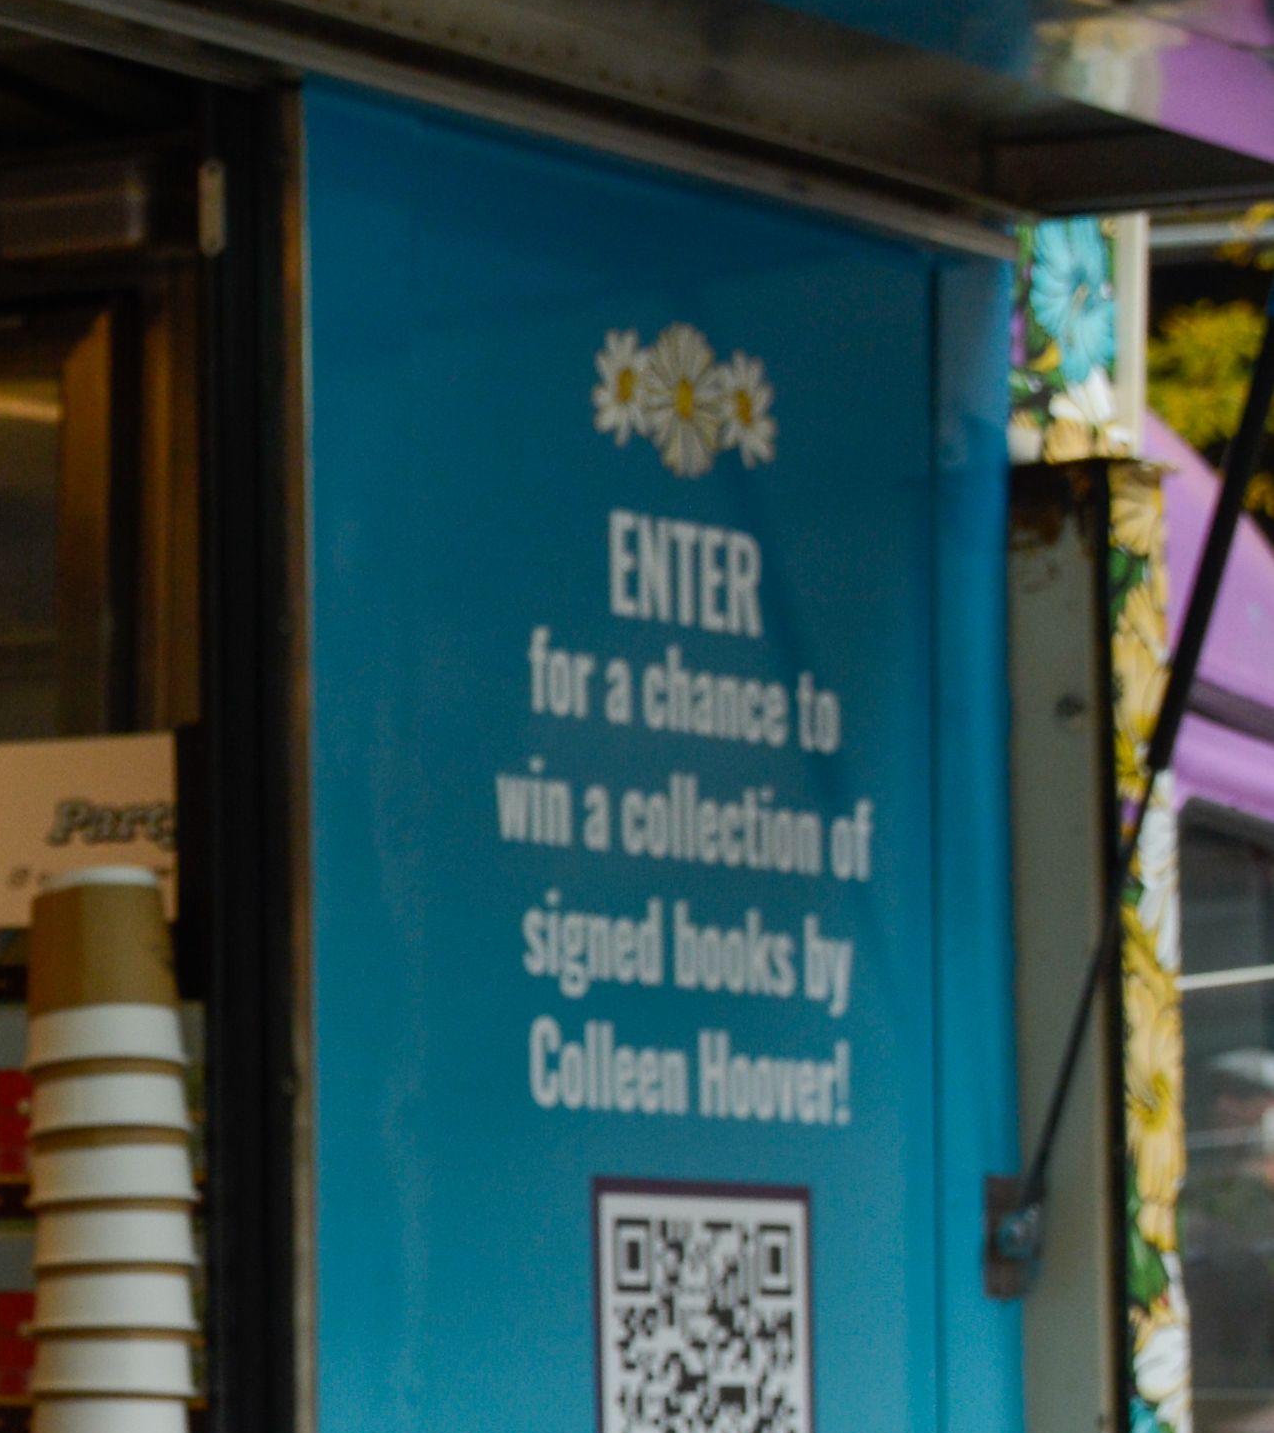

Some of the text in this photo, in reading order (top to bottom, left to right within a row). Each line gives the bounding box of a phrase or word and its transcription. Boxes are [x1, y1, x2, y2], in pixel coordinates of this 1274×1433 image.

[609, 509, 762, 638] ENTER
[528, 625, 840, 754] for a chance to
[495, 757, 873, 881] win a collection of
[522, 889, 853, 1019] signed books by
[529, 1015, 852, 1127] Colleen Hoover!
